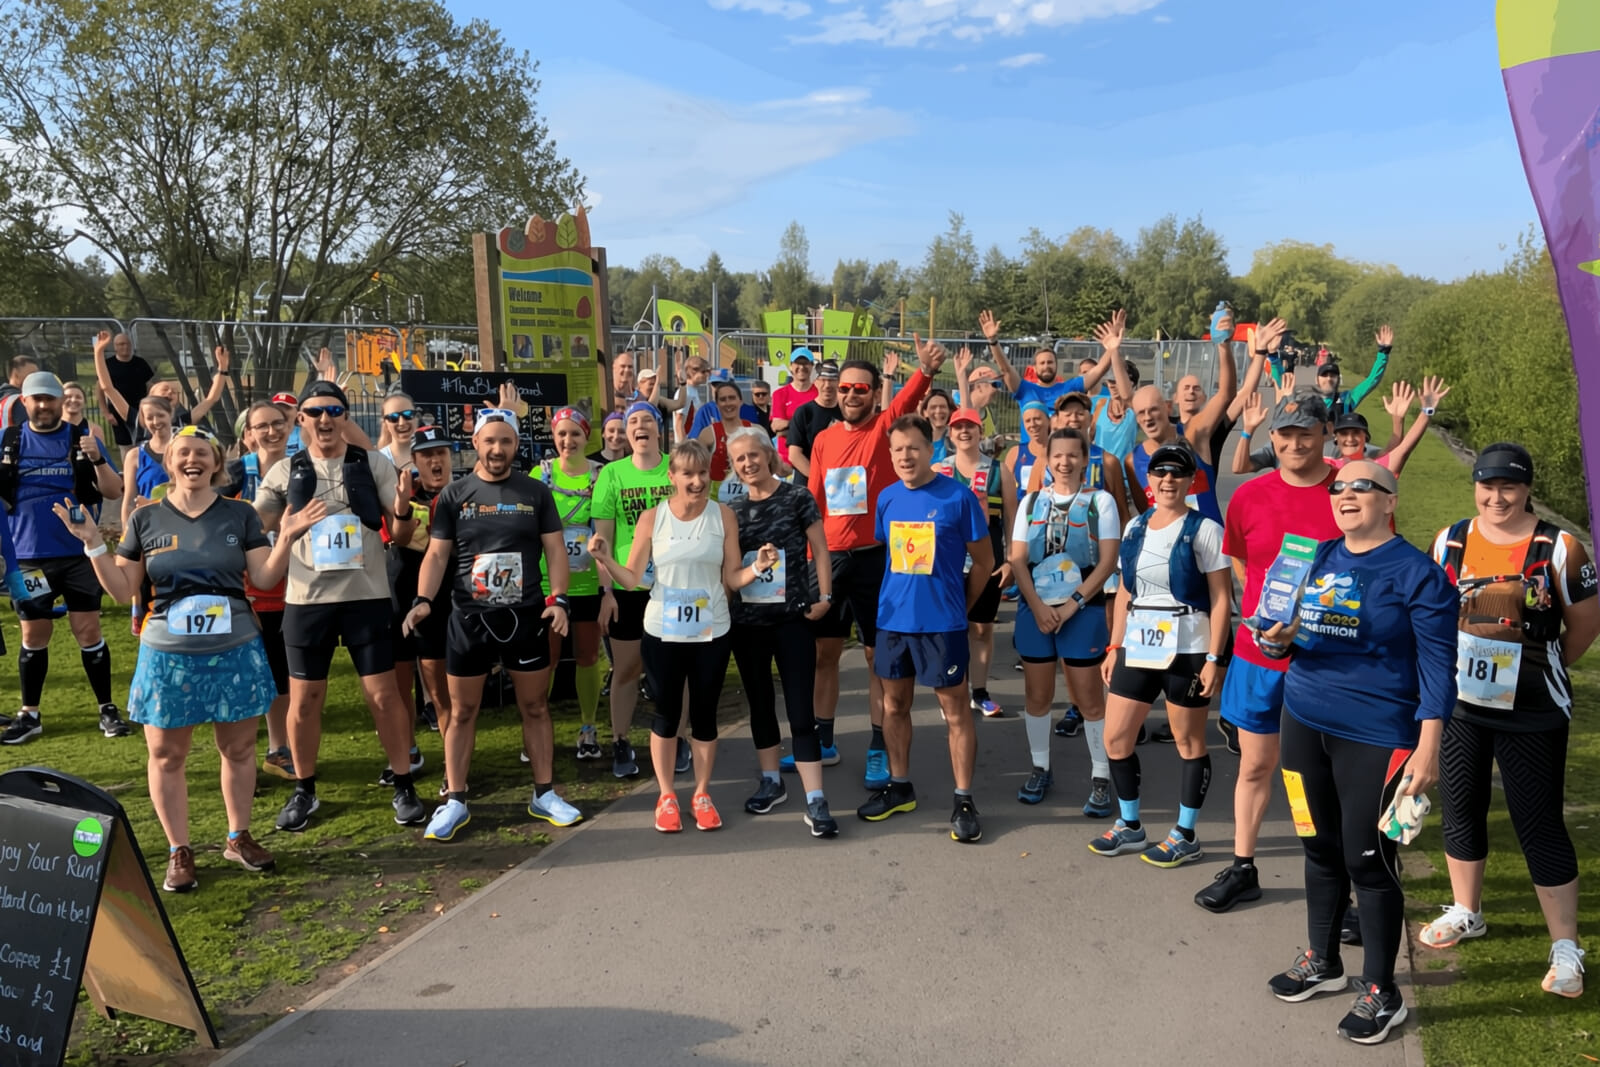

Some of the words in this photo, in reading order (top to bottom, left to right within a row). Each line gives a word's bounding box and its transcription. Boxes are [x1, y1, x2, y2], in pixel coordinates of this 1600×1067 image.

[727, 482, 743, 495] 172
[622, 498, 647, 511] CAN
[327, 531, 350, 550] 141
[906, 536, 915, 554] 6
[484, 561, 513, 588] 167
[24, 576, 43, 593] 84
[677, 605, 700, 622] 191
[1323, 612, 1360, 627] 2020
[186, 614, 217, 633] 197
[1300, 622, 1358, 638] ARATHON
[1140, 627, 1165, 647] 129
[1466, 656, 1498, 683] 181
[27, 841, 60, 872] Your
[65, 853, 102, 883] Run!
[29, 892, 52, 916] Can
[57, 897, 67, 919] it
[0, 943, 41, 969] Coffee
[16, 1034, 44, 1055] and
